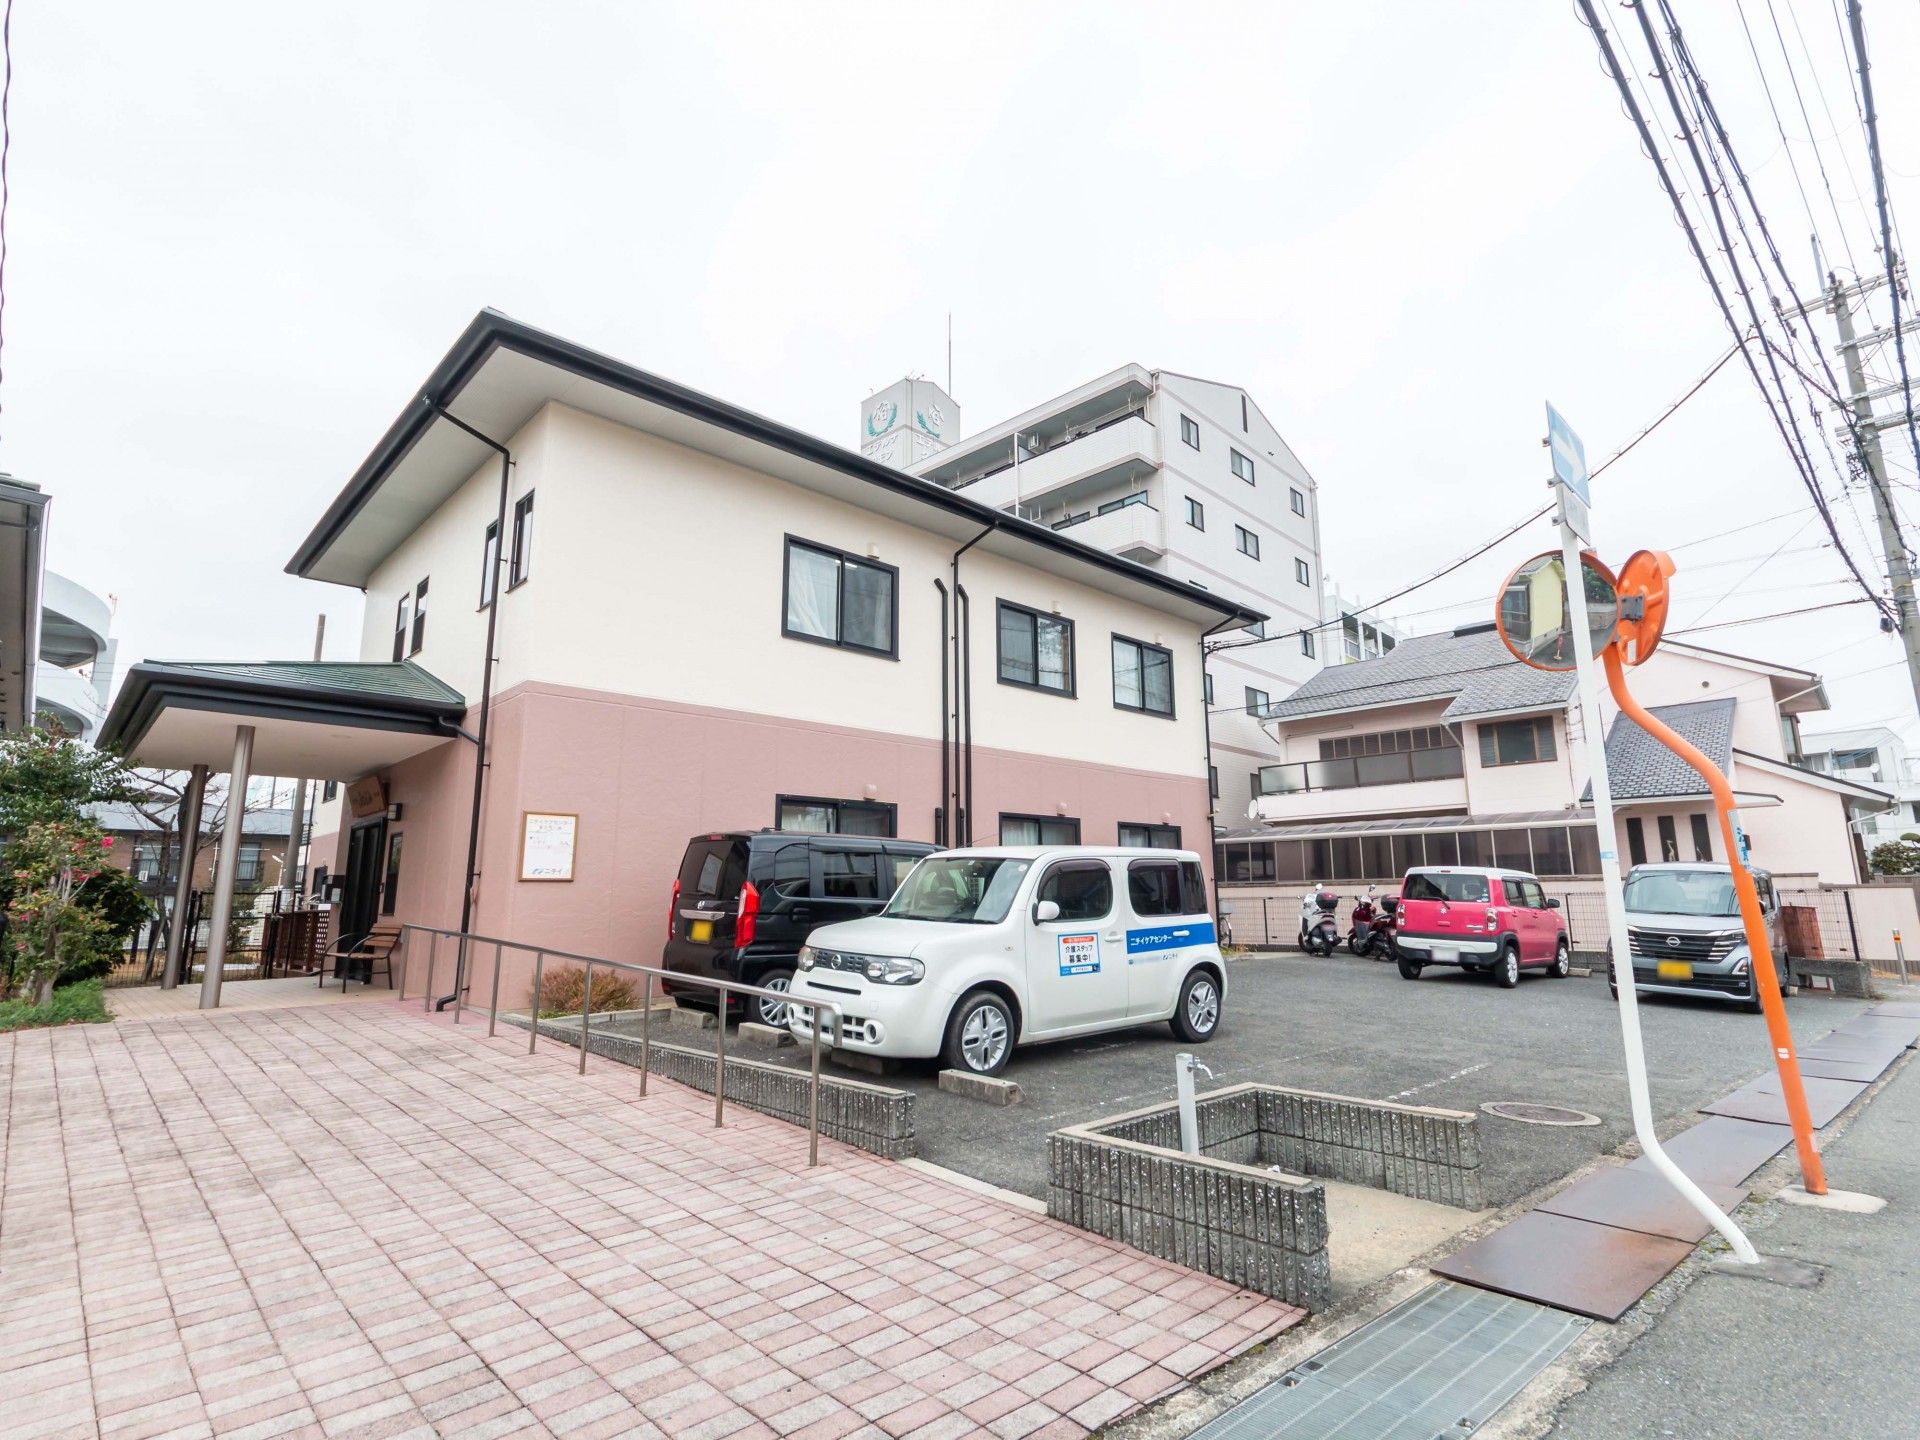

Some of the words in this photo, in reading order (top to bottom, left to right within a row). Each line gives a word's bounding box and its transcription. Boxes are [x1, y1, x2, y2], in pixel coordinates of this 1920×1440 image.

[1130, 934, 1172, 947] ニチイケアセンター
[1065, 944, 1093, 954] 介護スタッフ
